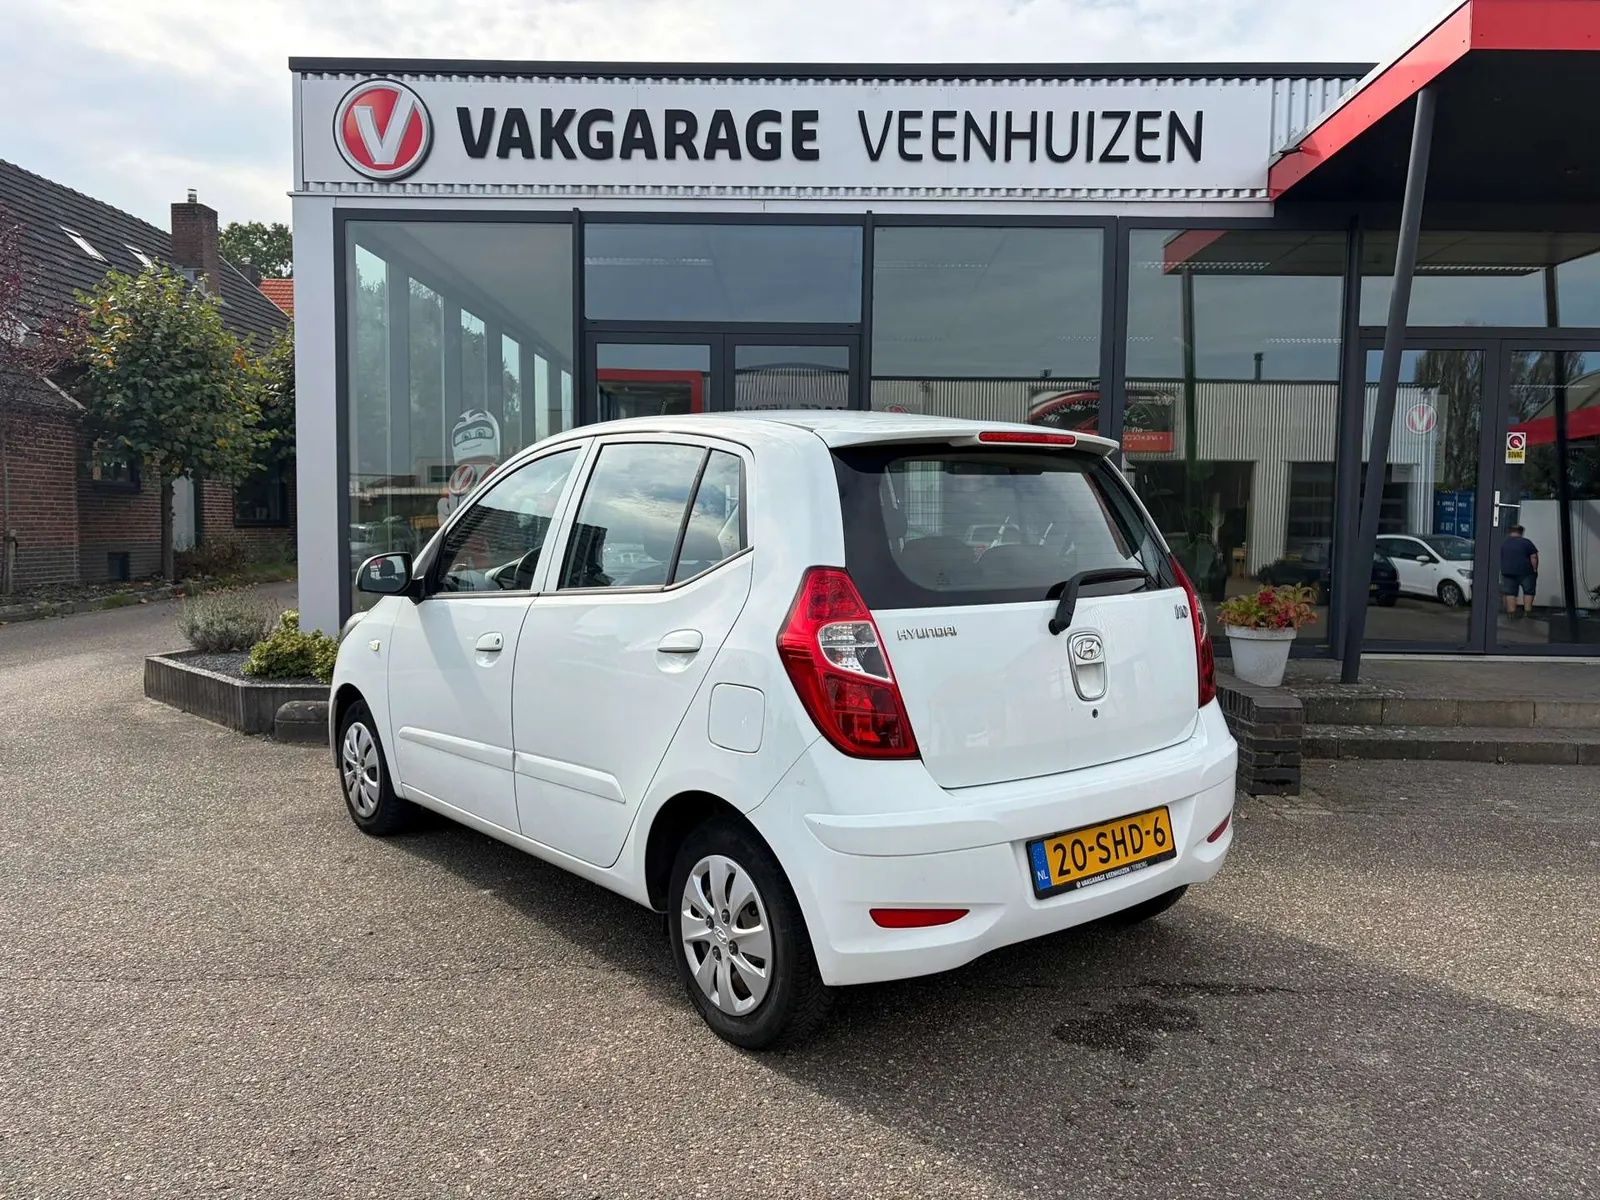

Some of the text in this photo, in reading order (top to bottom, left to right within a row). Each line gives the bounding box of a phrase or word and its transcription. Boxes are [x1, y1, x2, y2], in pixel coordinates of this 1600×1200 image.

[456, 107, 1203, 163] VAKGARAGE VEENHUIZEN
[896, 625, 958, 641] HYUNDAI
[1053, 816, 1167, 878] 20-SHD-6
[1037, 870, 1049, 881] NL
